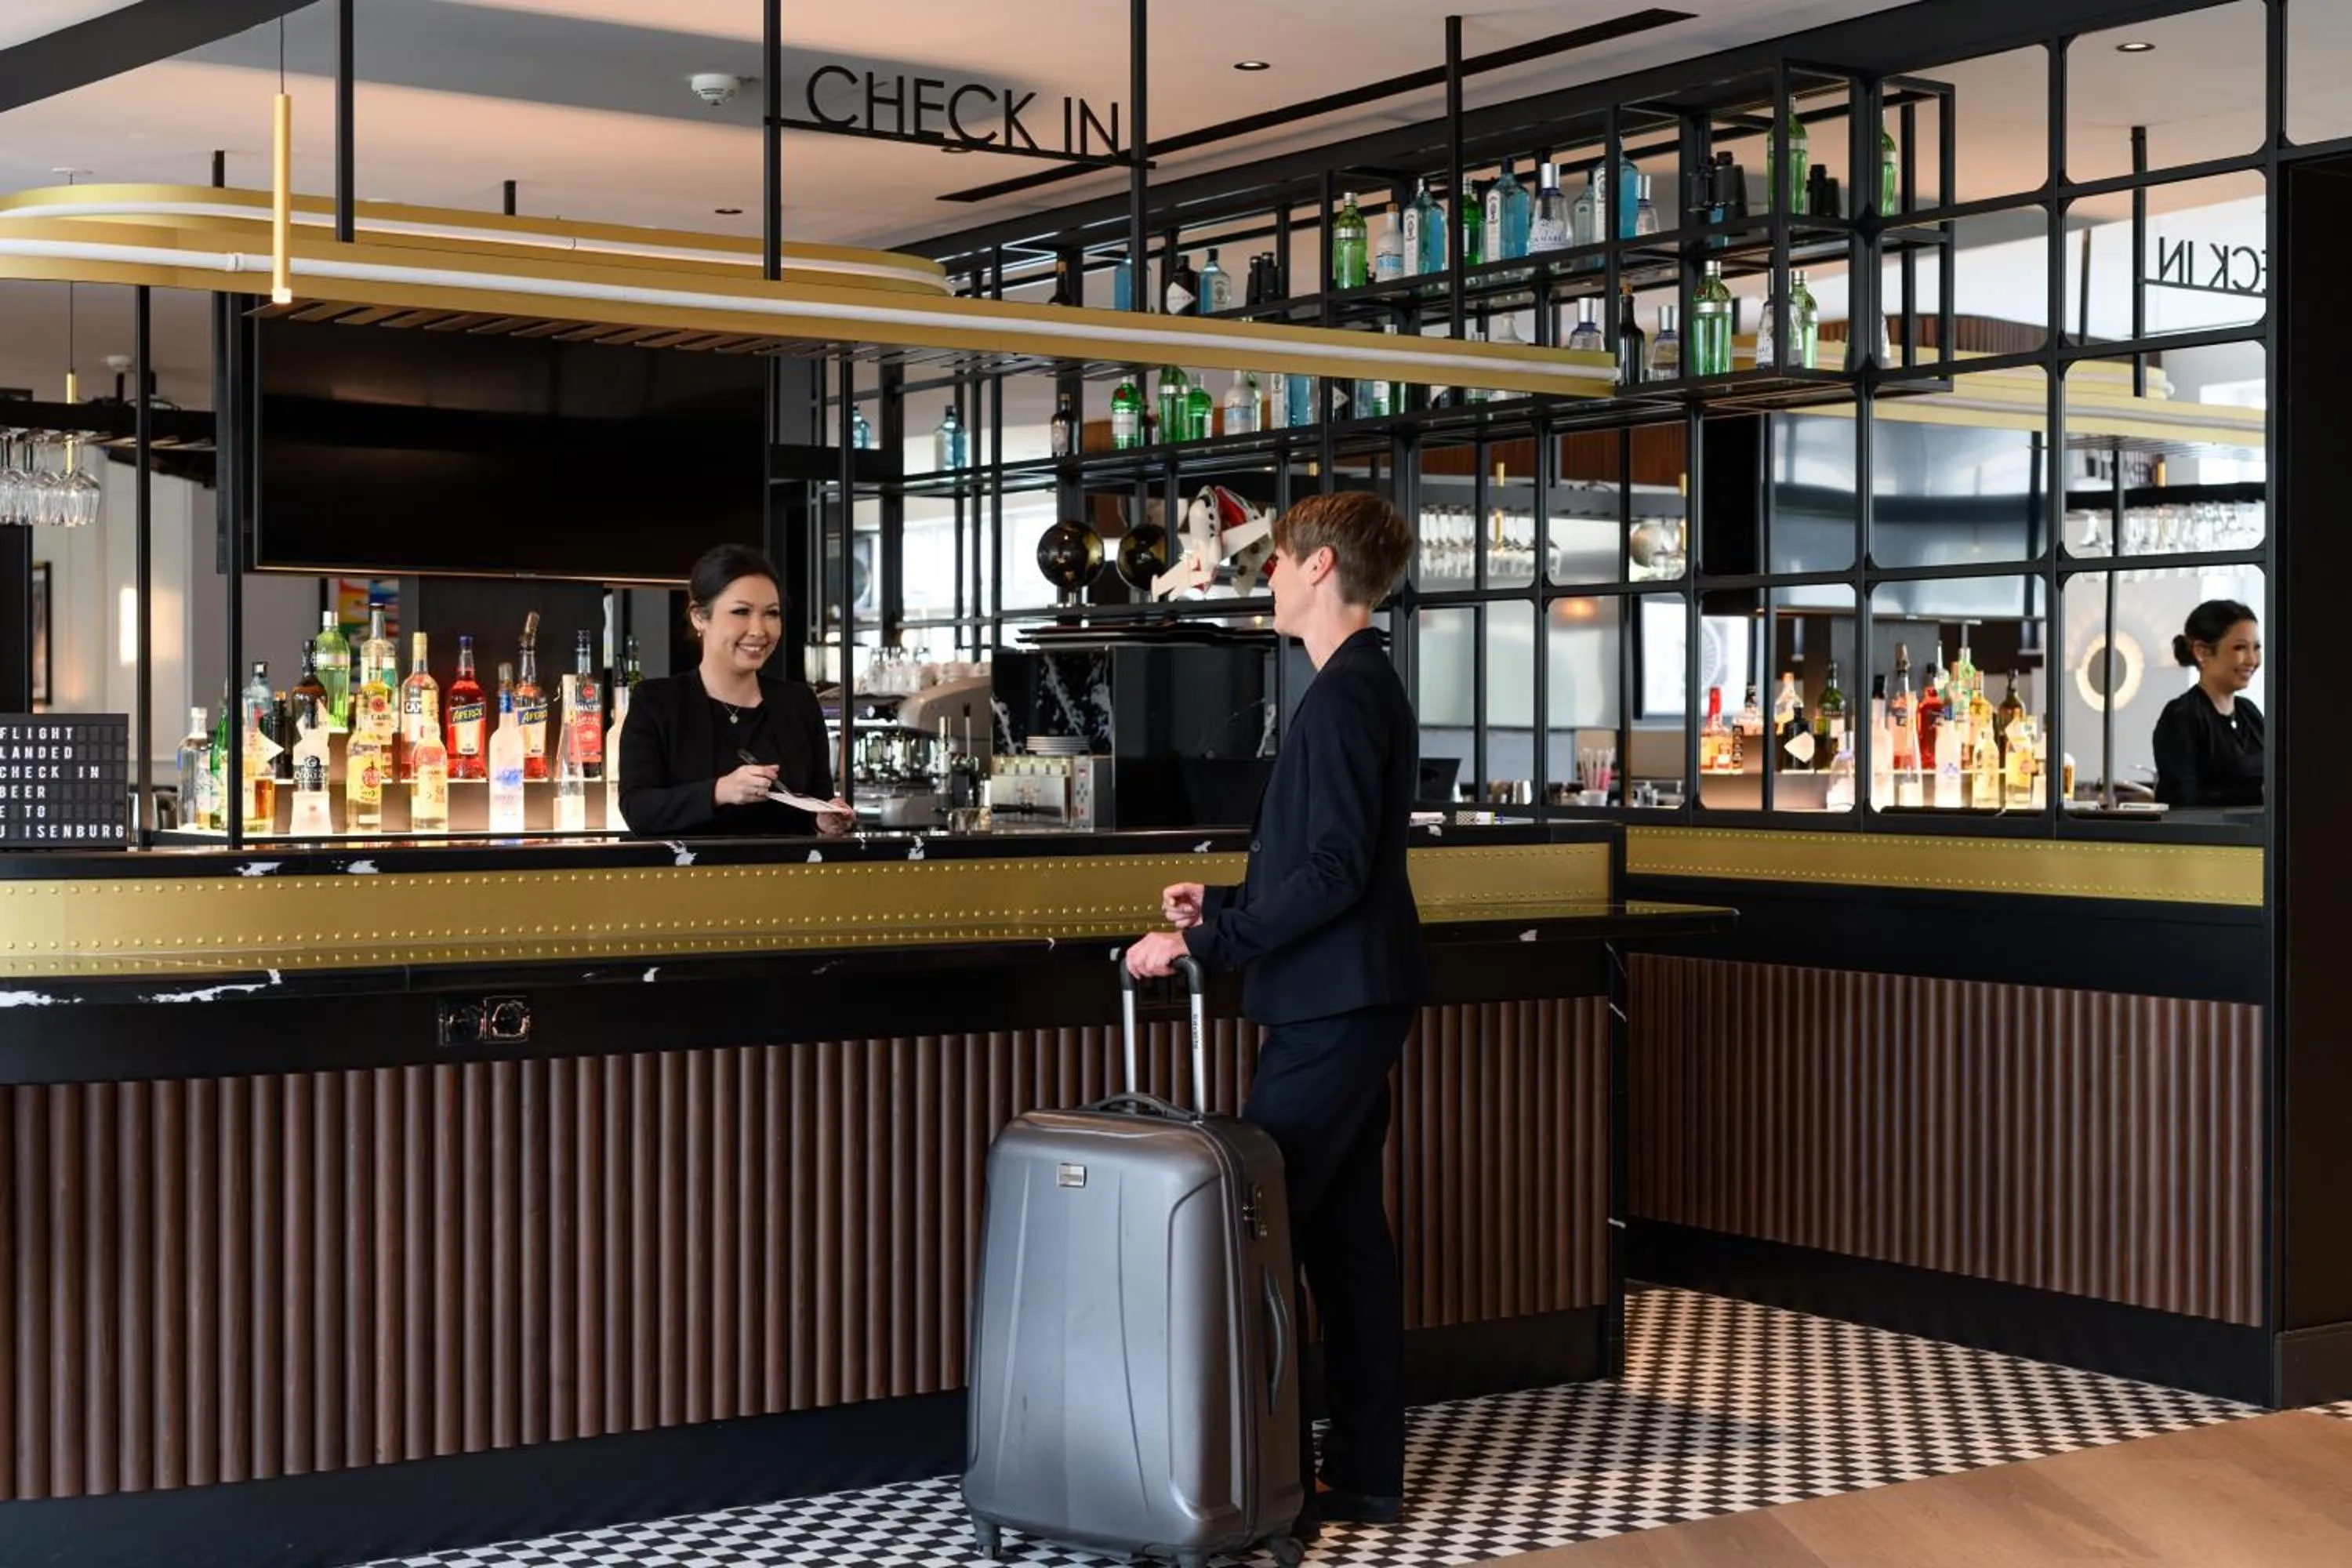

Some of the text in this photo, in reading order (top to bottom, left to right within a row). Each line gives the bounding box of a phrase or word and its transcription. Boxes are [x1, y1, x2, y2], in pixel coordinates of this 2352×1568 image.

[806, 65, 1119, 155] CHECK IN
[0, 727, 73, 739] FLIGHT
[0, 746, 73, 760] LANDED
[0, 766, 100, 779] CHECK IN
[0, 785, 45, 798] BEER
[24, 804, 45, 818] TO
[25, 825, 124, 838] ISENBURG
